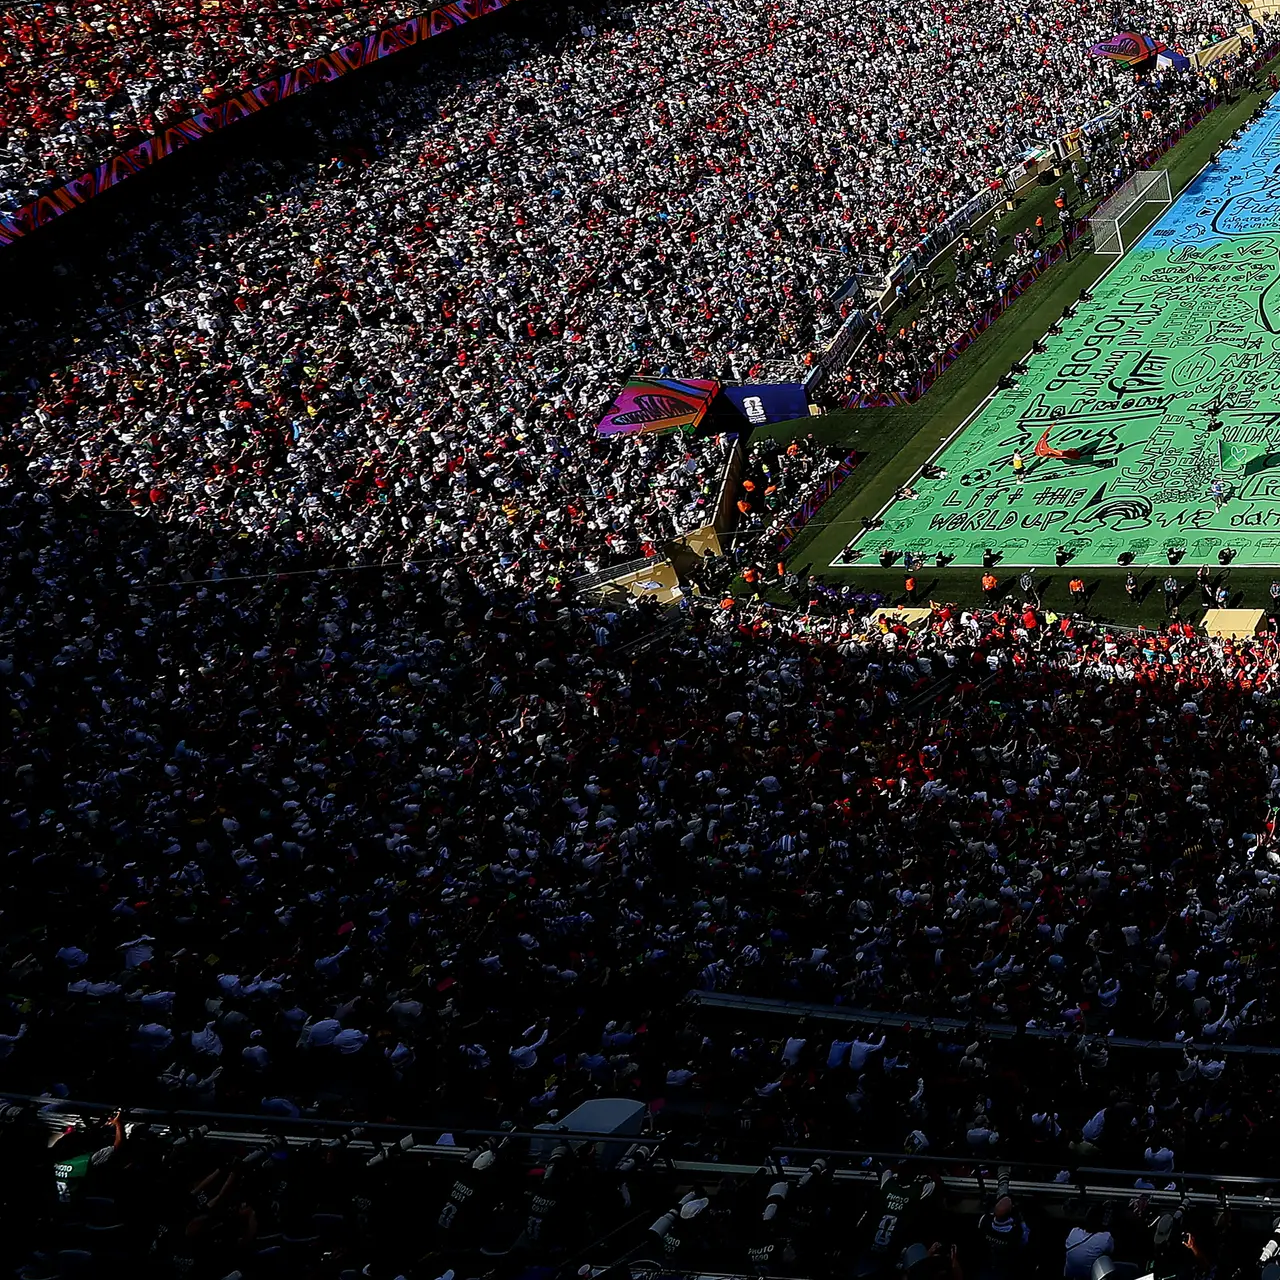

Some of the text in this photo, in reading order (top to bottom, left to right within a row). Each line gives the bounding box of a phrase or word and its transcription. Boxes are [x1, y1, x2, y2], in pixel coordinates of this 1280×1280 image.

[1108, 414, 1186, 492] IGNITE
[1138, 446, 1184, 494] YOUR
[928, 508, 1019, 531] WORLD
